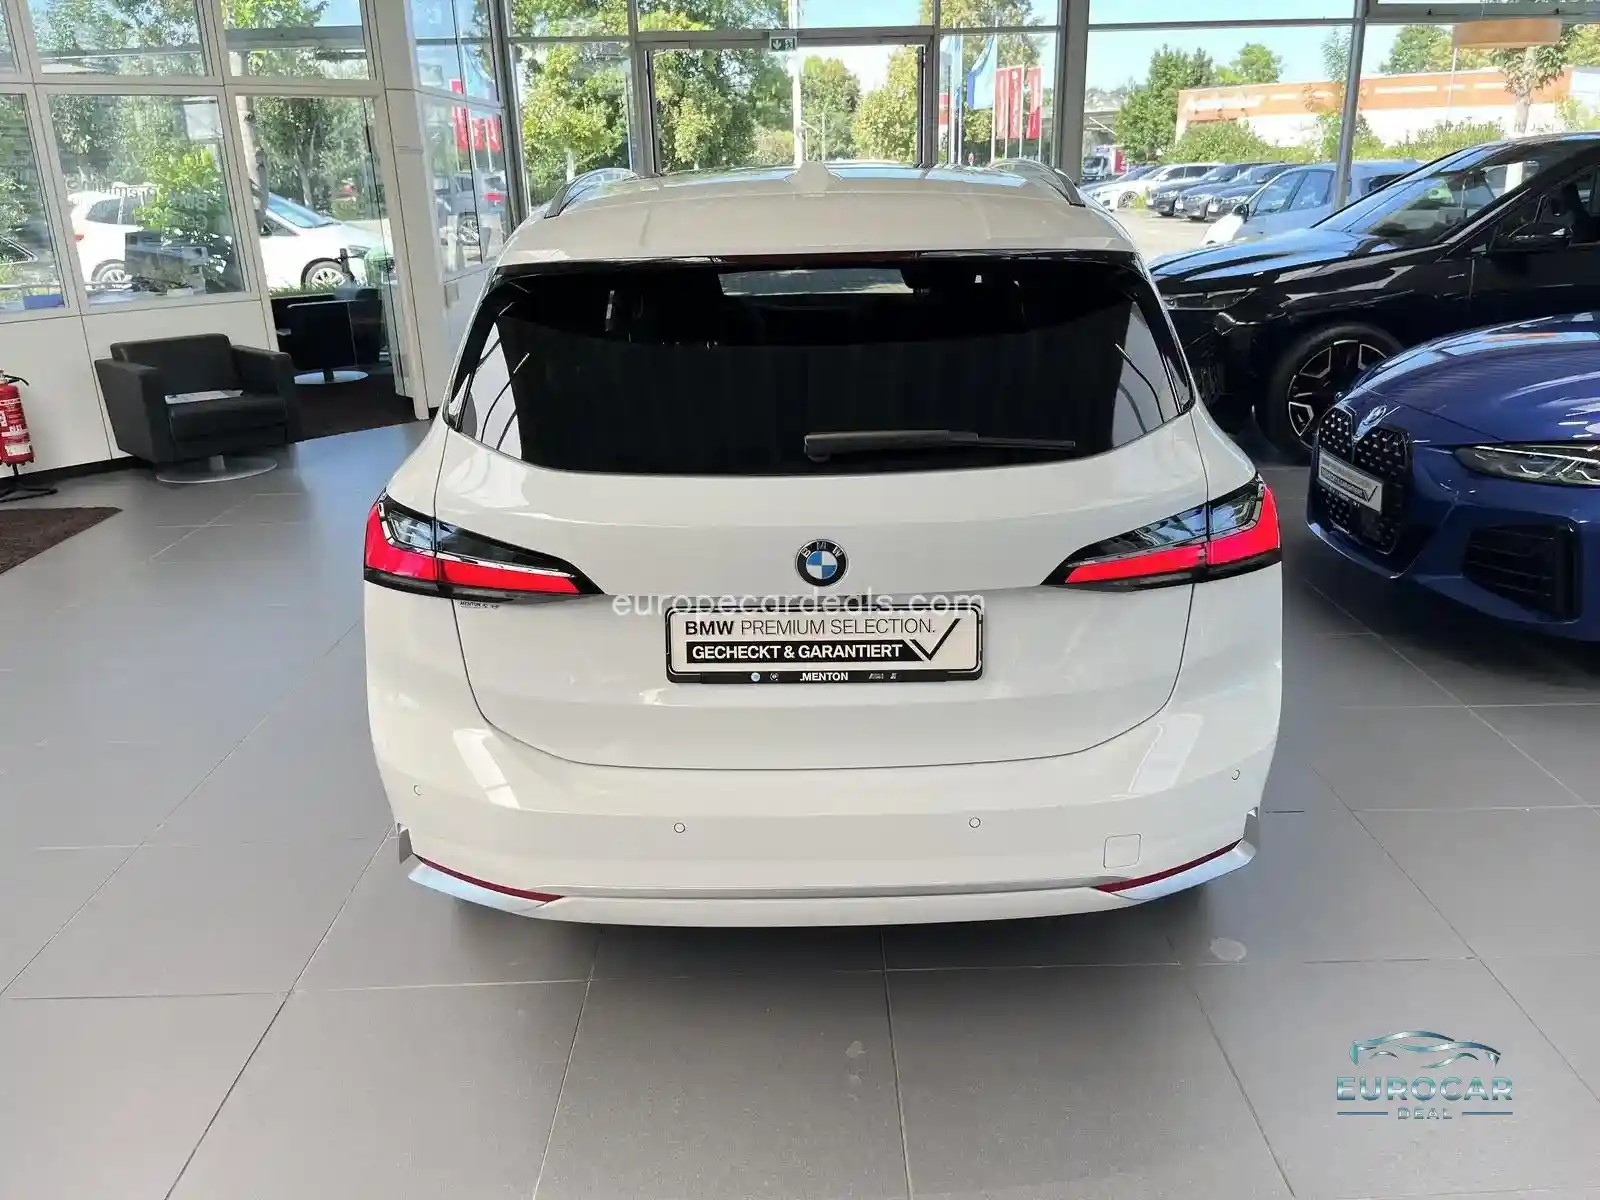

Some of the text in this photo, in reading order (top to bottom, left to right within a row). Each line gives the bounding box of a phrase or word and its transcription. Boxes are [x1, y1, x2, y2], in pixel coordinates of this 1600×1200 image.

[801, 541, 843, 559] BMW
[685, 618, 936, 635] BMW PREMIUM SELECTION.
[692, 644, 903, 659] GECHECKT & GARANTIERT
